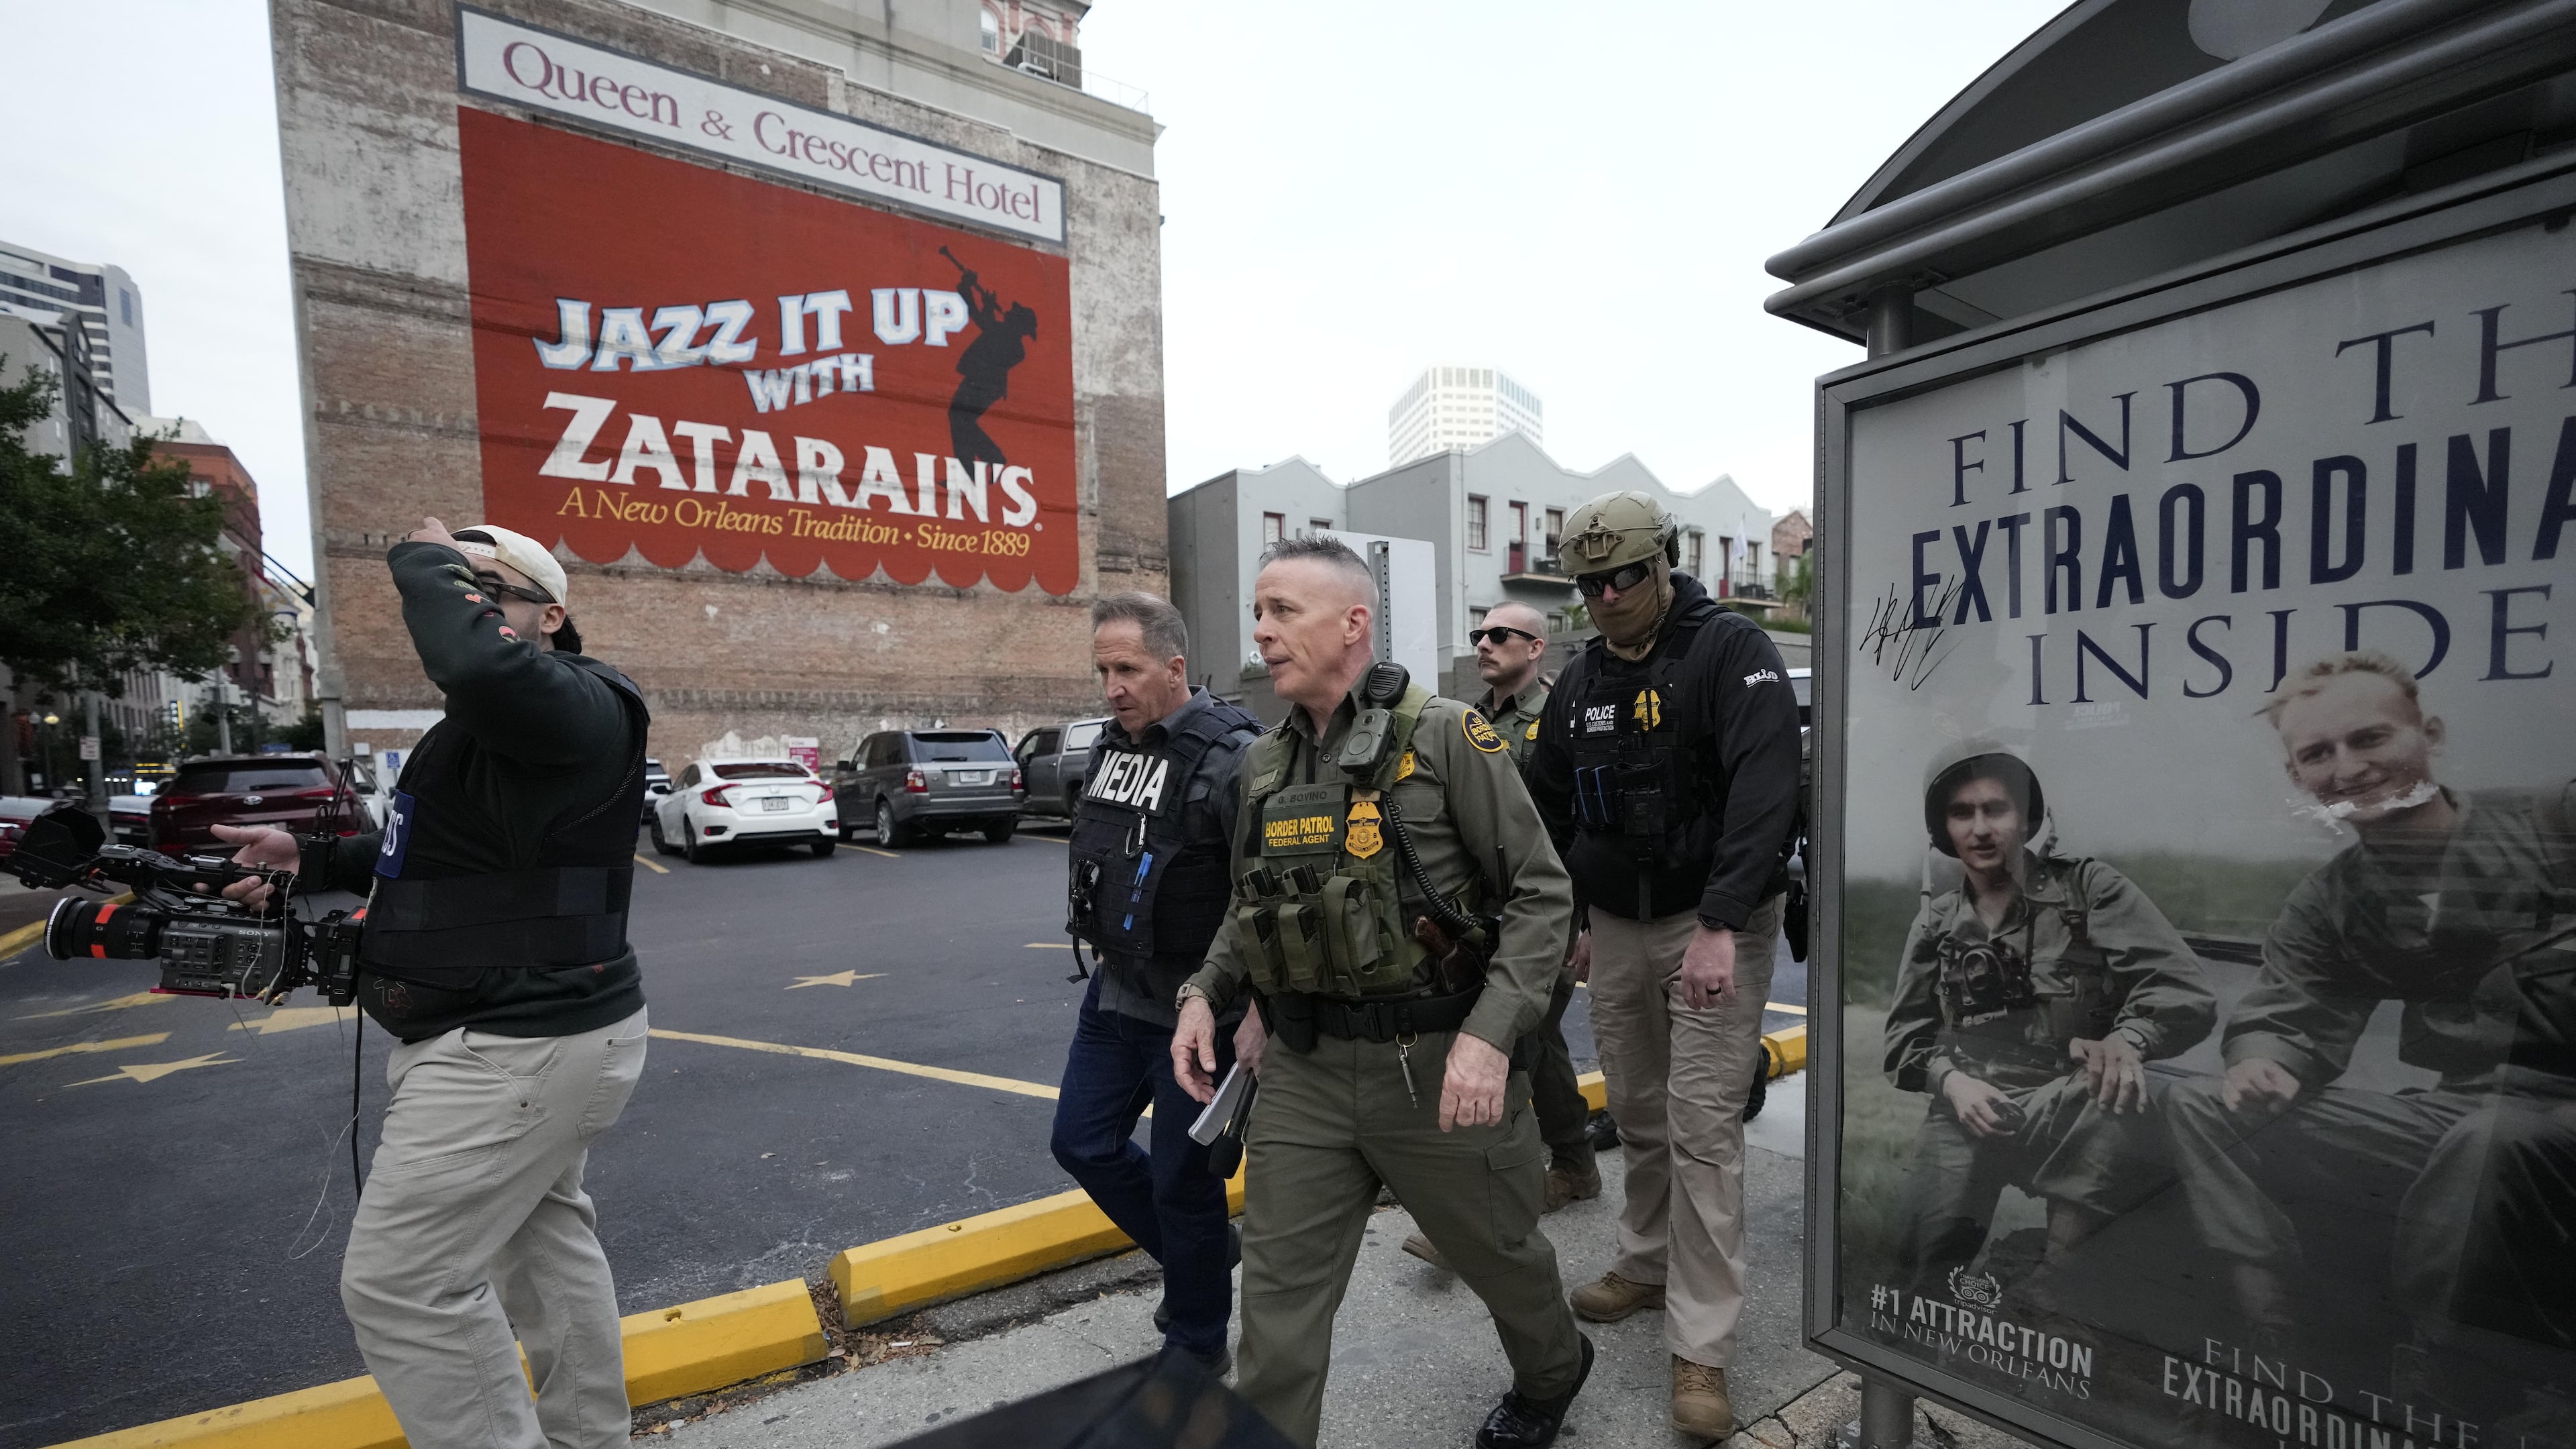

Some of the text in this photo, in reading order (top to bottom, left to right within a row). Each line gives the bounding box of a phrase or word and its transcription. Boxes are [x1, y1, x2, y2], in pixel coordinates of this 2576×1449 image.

[502, 40, 1041, 224] Queen & Crescent Hotel
[533, 288, 970, 372] JAZZ IT UP
[743, 353, 875, 413] WITH
[539, 391, 1038, 529] ZATARAIN'S
[1947, 372, 2261, 508] FIND
[557, 486, 1030, 558] A New Orleans Tradition Since 1889
[2026, 583, 2554, 706] INSIDE
[1585, 704, 1616, 722] POLICE
[1087, 750, 1169, 810] MEDIA
[1278, 791, 1327, 804] G. BOVINO
[1265, 816, 1334, 837] BORDER PATROL
[1269, 834, 1330, 847] FEDERAL AGENT
[239, 929, 271, 937] SONY
[1954, 1298, 1995, 1315] tripadvisor
[1960, 1278, 1989, 1290] CHOICE
[1870, 1311, 2091, 1400] IN NEW ORLEANS
[1871, 1283, 2092, 1378] #1 ATTRACTION
[2202, 1336, 2334, 1404] FIND
